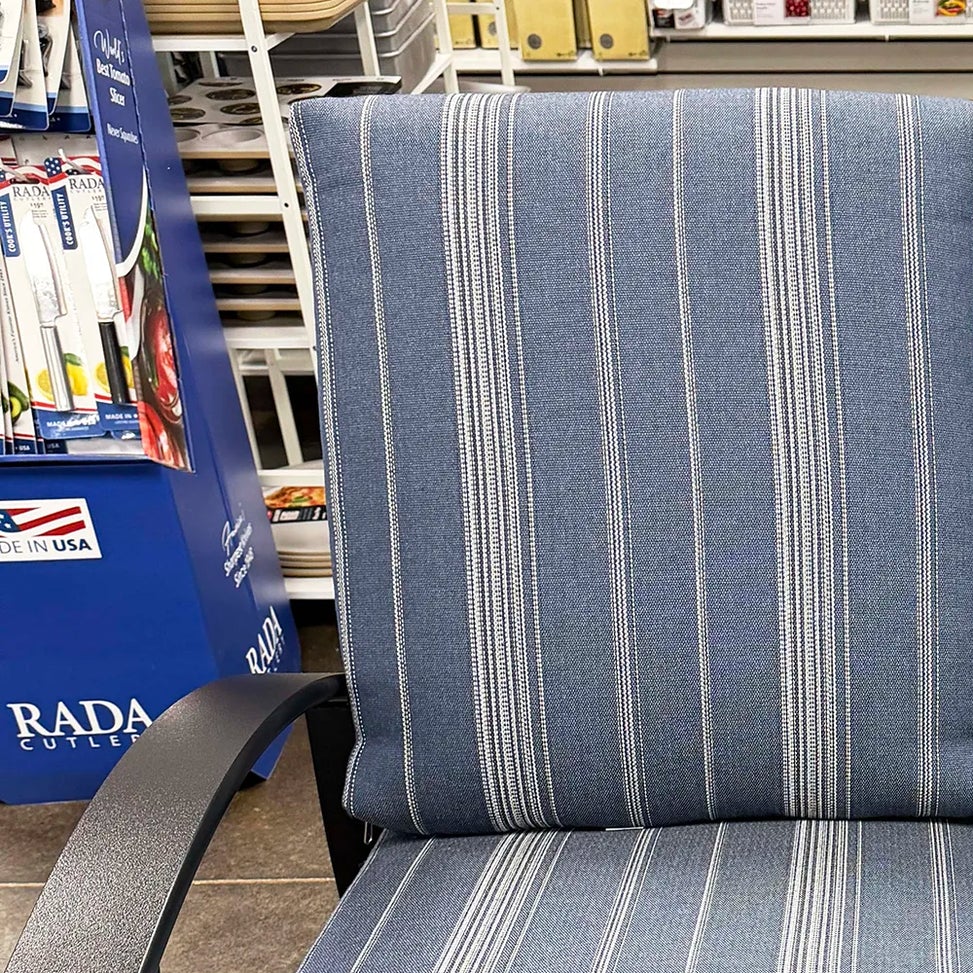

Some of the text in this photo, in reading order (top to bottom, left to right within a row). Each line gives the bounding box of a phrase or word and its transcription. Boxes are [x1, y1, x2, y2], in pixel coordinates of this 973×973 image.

[93, 28, 125, 65] World's
[96, 58, 131, 86] Best Tomato
[109, 87, 125, 106] Slicer
[107, 123, 120, 138] Never
[12, 186, 50, 197] RADA
[69, 178, 105, 189] RADA
[0, 201, 17, 252] COOK'S UTILITY
[56, 193, 74, 245] COOK'S UTILITY
[27, 540, 48, 552] IN
[52, 538, 92, 551] USA
[246, 605, 282, 674] RADA
[6, 698, 153, 737] RADA
